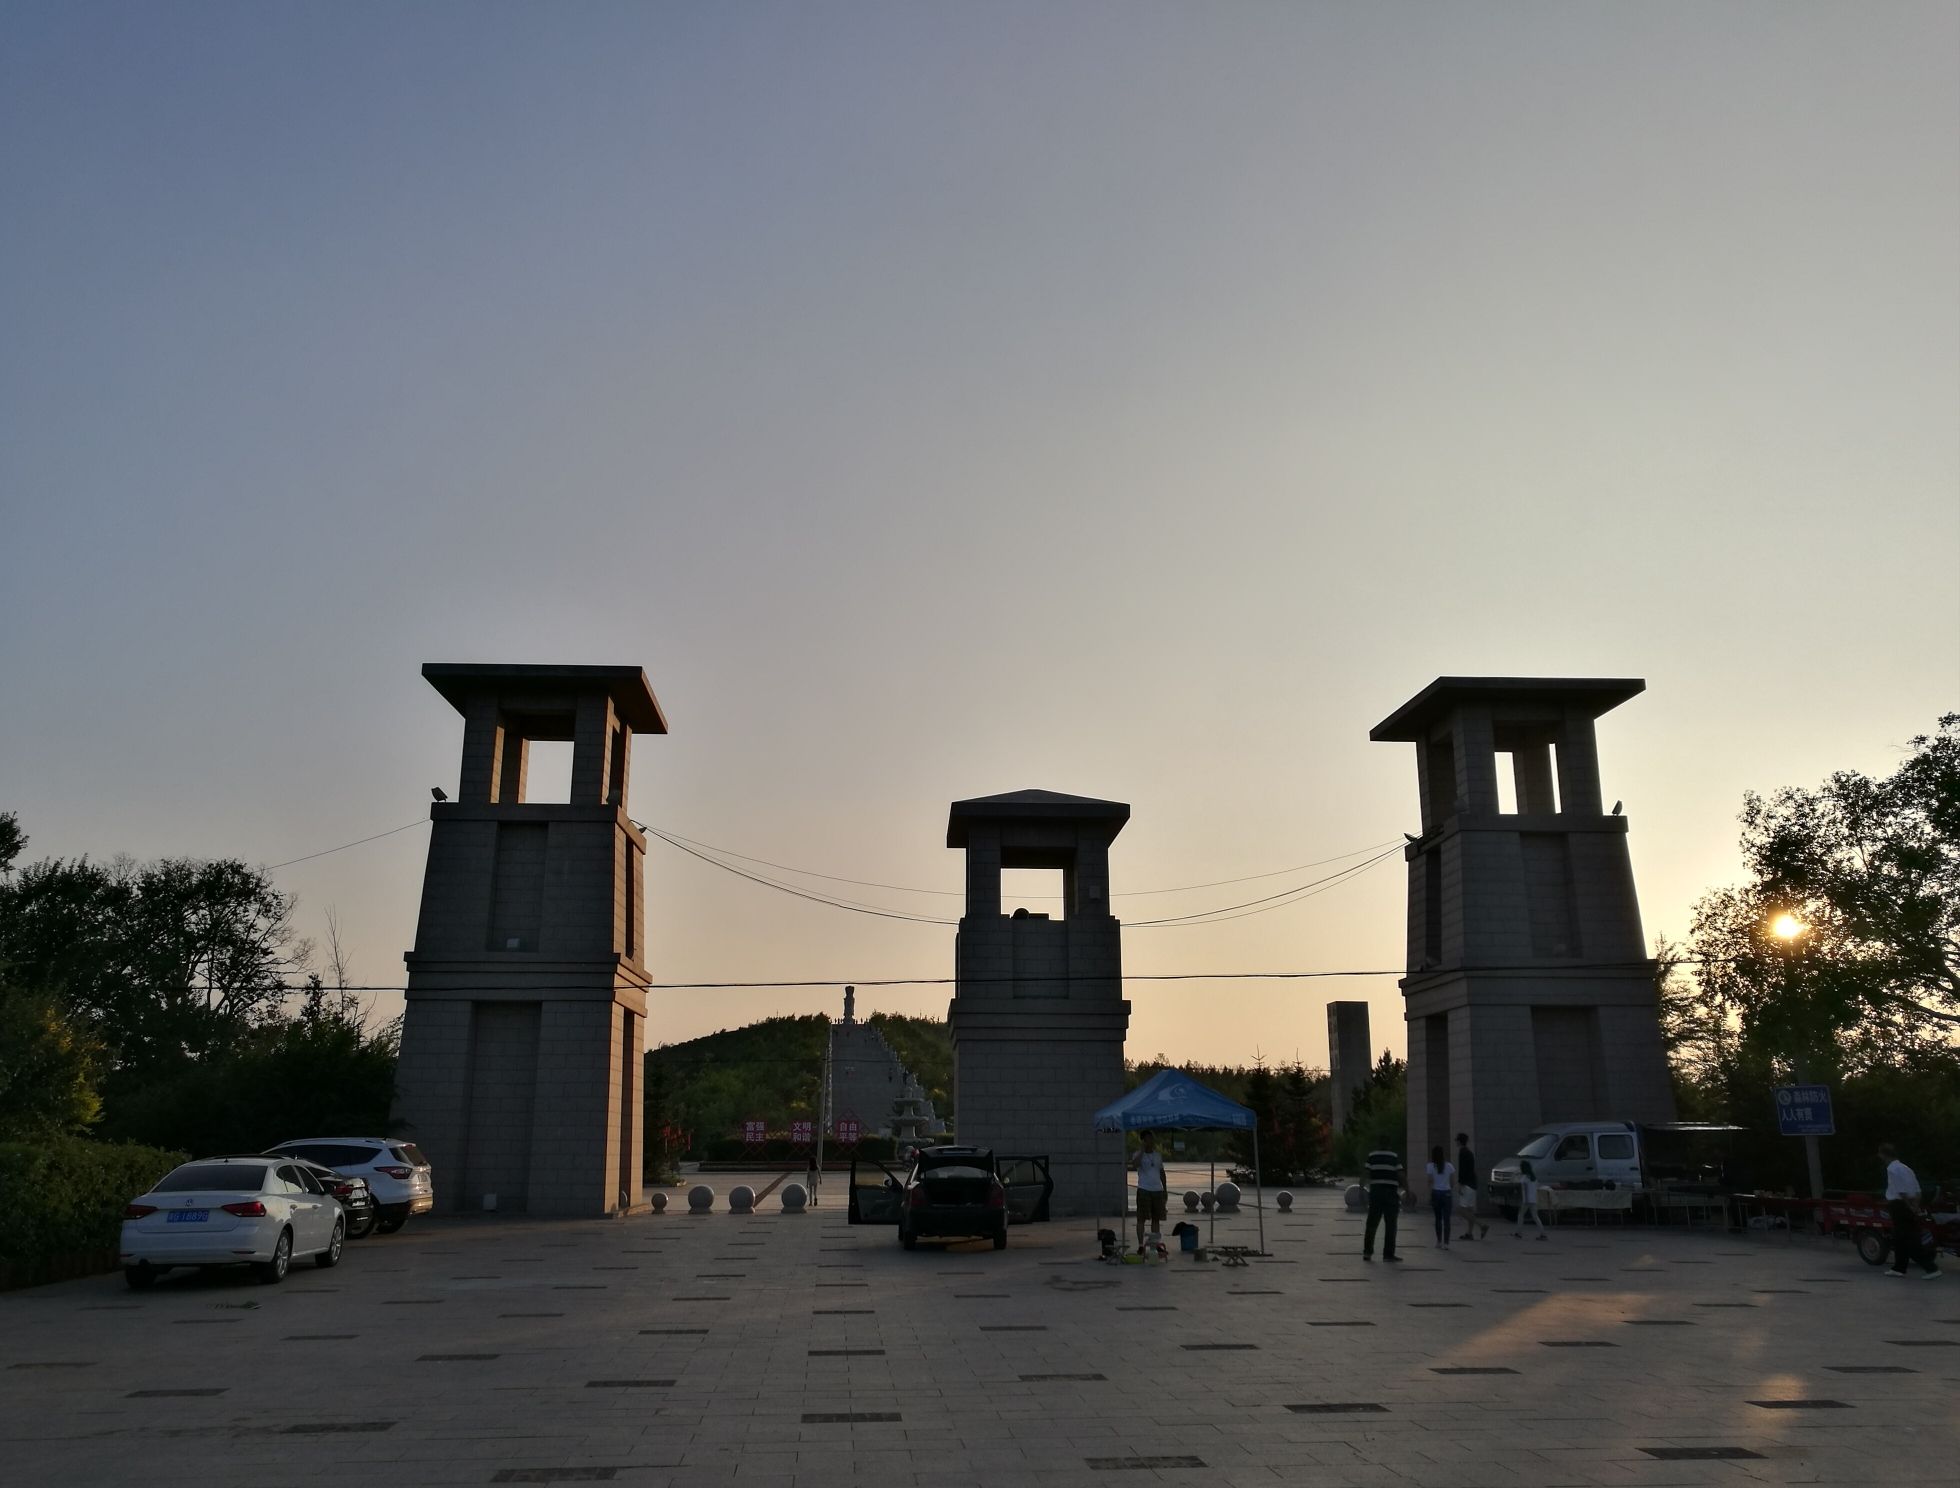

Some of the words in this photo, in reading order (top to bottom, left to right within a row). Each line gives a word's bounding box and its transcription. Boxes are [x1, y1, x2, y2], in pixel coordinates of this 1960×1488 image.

[745, 1121, 765, 1132] 富强
[793, 1121, 812, 1132] 文明
[839, 1122, 857, 1132] 自由
[745, 1132, 765, 1142] 民主
[793, 1132, 812, 1143] 和谐
[839, 1132, 857, 1143] 平等
